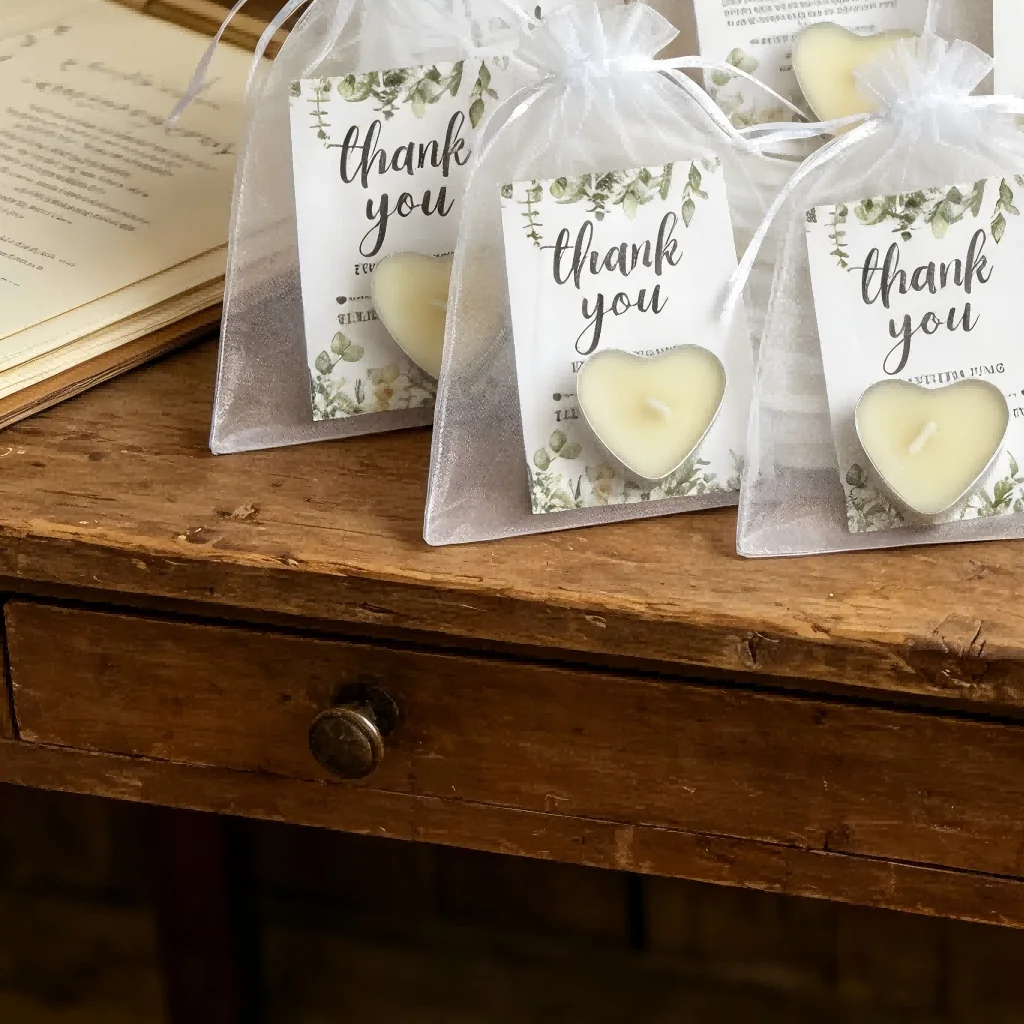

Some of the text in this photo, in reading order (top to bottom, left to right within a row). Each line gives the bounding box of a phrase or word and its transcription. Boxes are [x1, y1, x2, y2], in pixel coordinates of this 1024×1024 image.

[329, 110, 472, 189] thank
[359, 186, 455, 258] you
[540, 211, 684, 290] thank
[847, 228, 994, 309] thank
[575, 284, 669, 356] you
[883, 302, 981, 375] you
